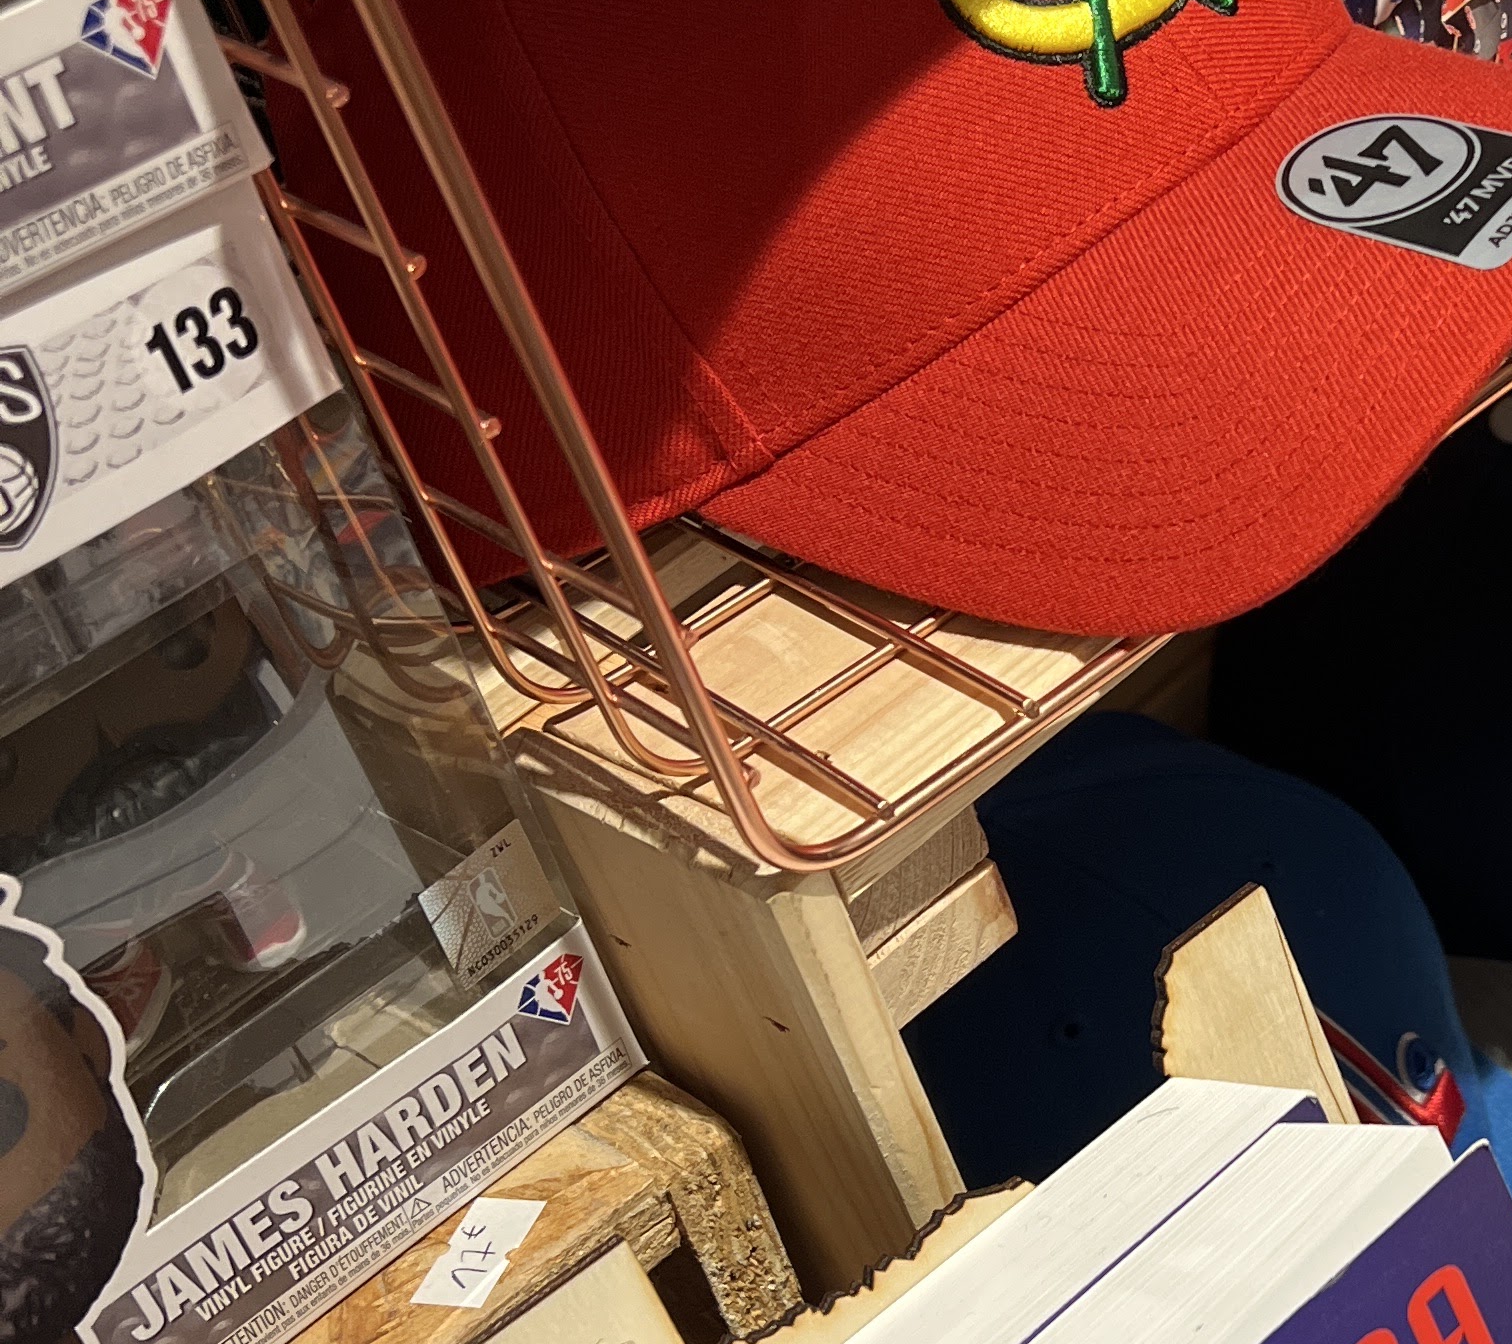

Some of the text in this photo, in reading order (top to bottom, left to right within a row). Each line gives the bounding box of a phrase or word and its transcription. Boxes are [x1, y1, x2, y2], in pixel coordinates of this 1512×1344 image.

[1443, 193, 1481, 228] '47
[145, 286, 259, 394] 133
[553, 960, 574, 986] 75
[440, 1046, 627, 1194] ADVERTENCIA: PELIGRO DE ASFIXIA.
[130, 1022, 528, 1343] JAMES HARDEN
[195, 1098, 492, 1323] VINYL FIGURE FIGURINE EN VINYLE
[288, 1175, 425, 1281] FIGURA DE VINIL
[288, 1270, 332, 1309] DANGER
[329, 1212, 410, 1279] D'ÉTOUFFEMENT.
